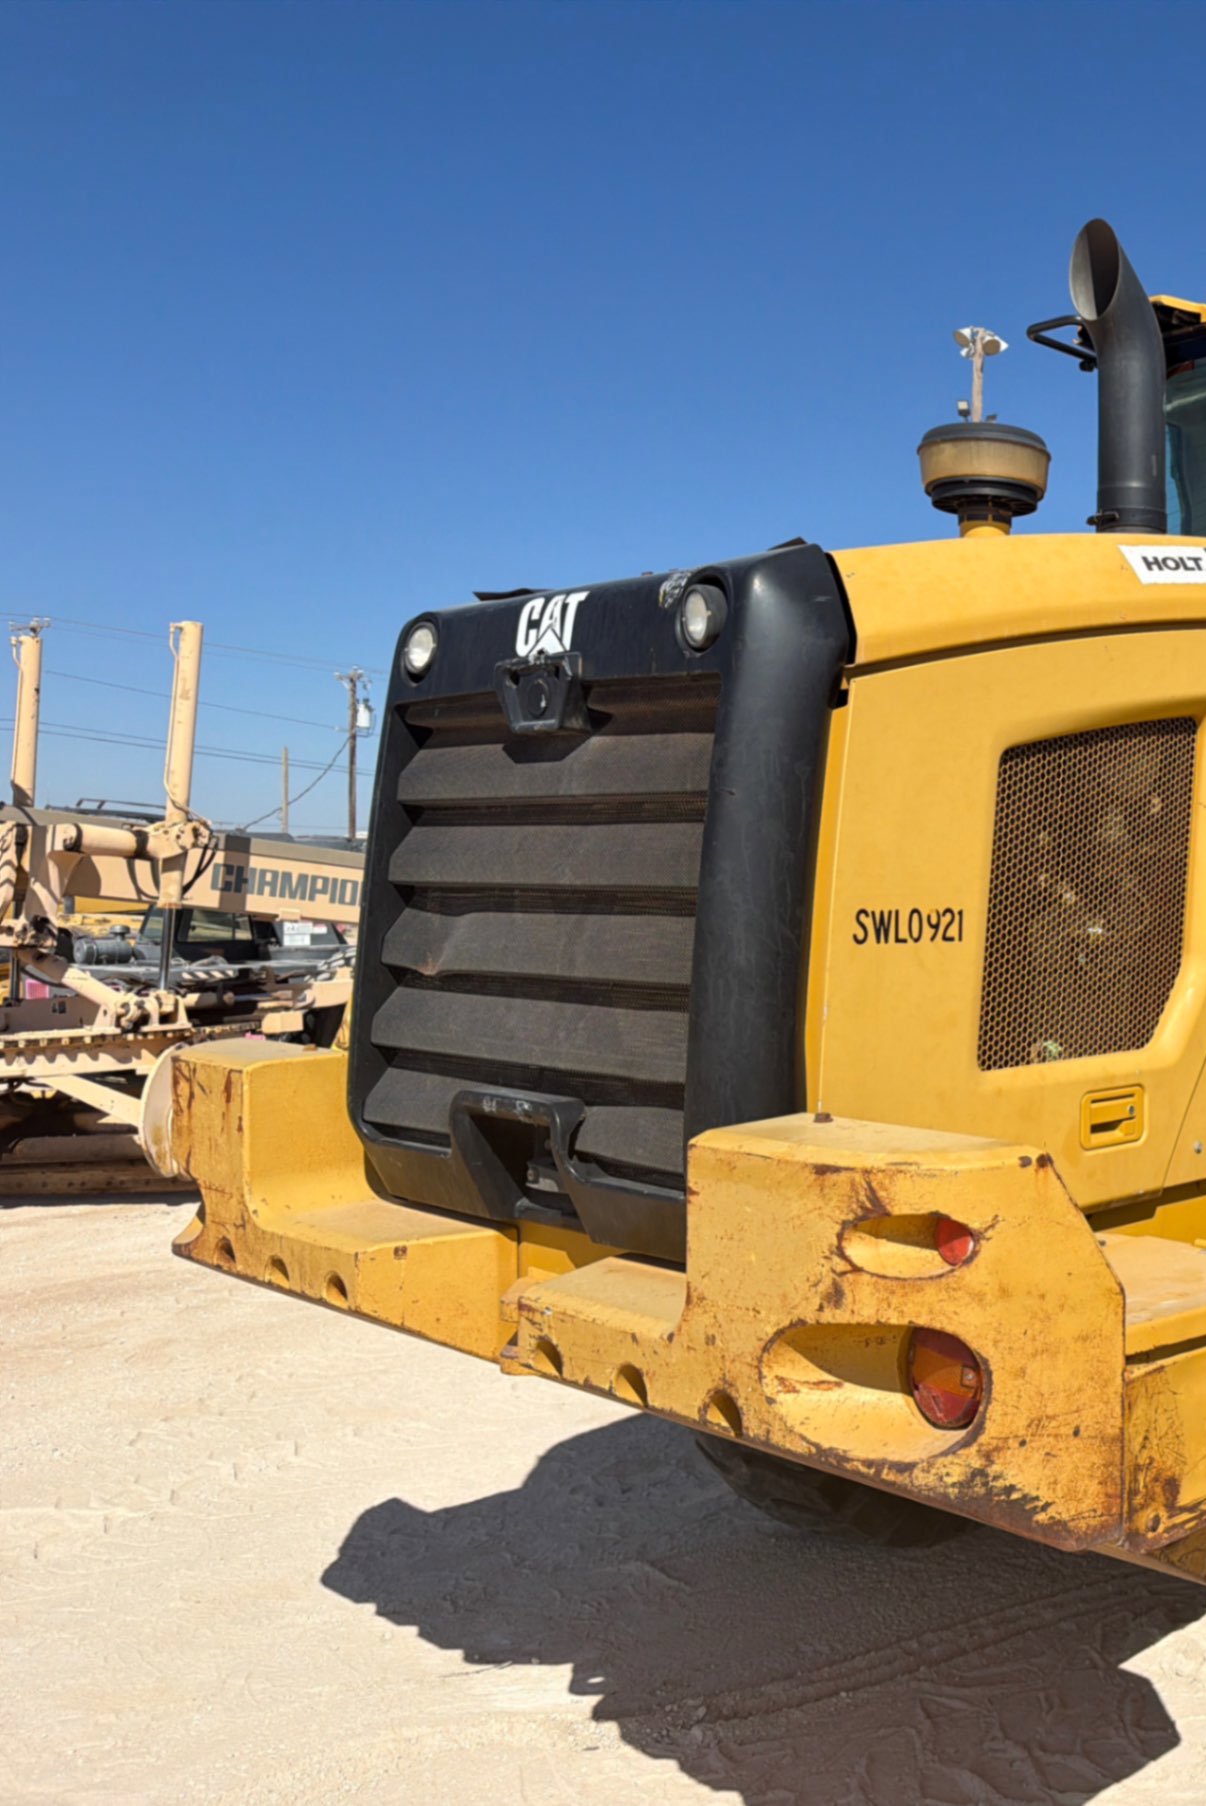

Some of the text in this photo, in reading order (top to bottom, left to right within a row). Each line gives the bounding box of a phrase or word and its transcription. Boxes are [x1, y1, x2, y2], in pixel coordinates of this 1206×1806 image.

[1141, 556, 1203, 572] HOLT
[515, 591, 591, 658] CAT
[210, 863, 366, 906] CHAMPIO
